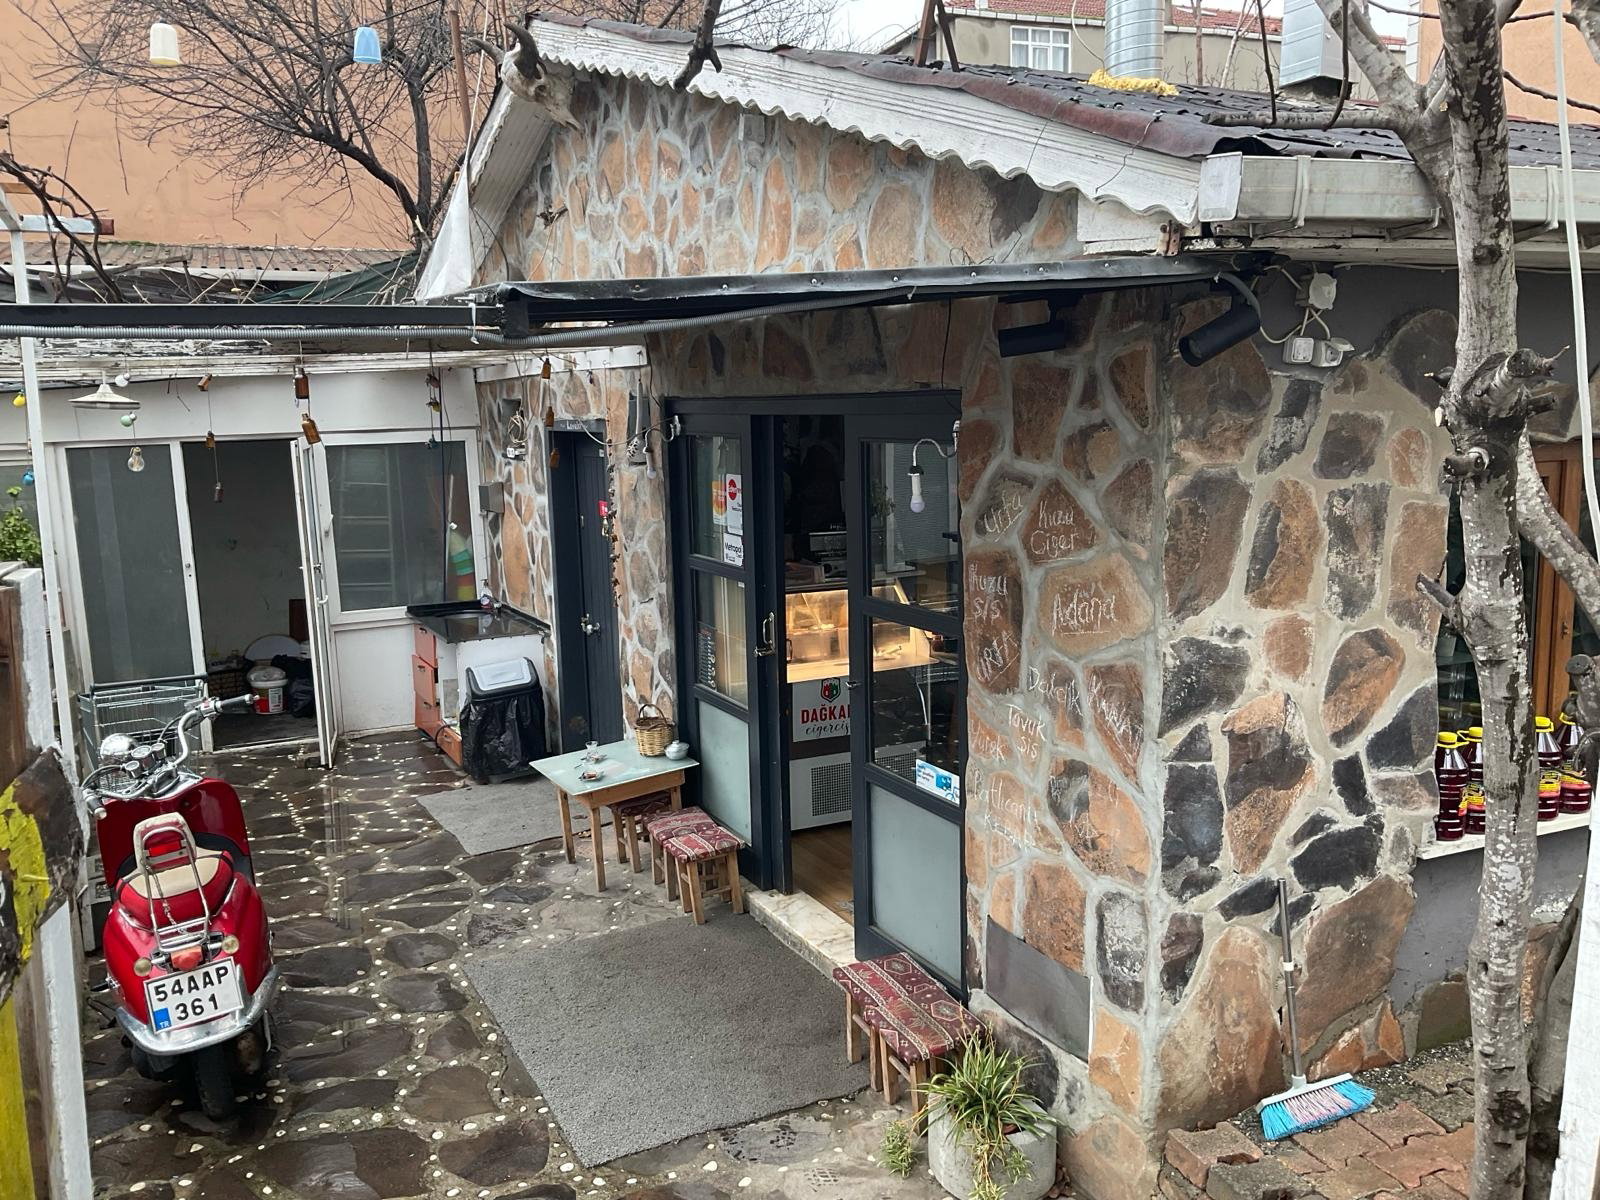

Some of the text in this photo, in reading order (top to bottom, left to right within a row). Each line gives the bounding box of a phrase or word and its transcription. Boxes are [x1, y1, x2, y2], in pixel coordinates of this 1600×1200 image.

[153, 965, 229, 1002] 54AAP
[175, 993, 218, 1021] 361
[160, 1021, 169, 1029] TR
